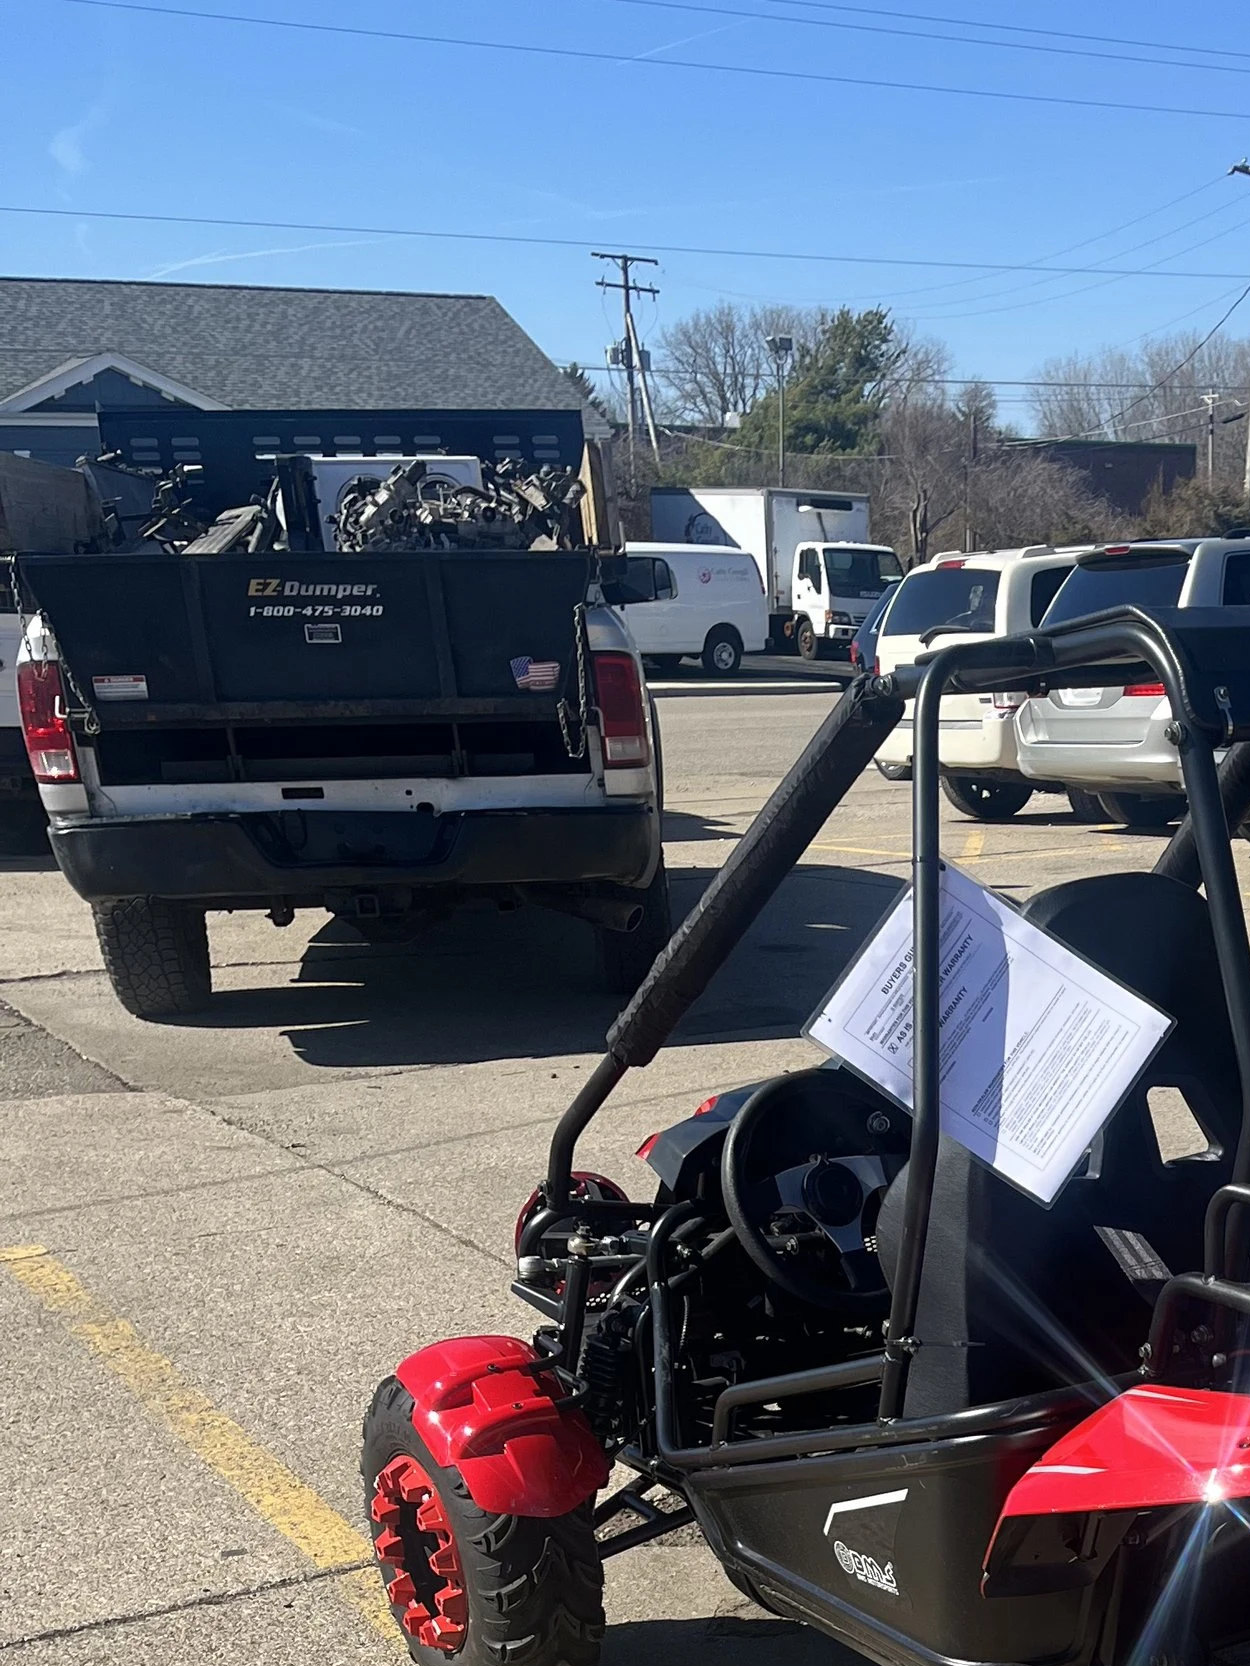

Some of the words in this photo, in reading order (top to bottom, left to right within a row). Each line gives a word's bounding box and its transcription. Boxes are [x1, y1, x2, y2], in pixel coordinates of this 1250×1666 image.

[248, 604, 383, 617] 1-800-475-3040
[880, 960, 907, 995] BUYERS
[895, 1029, 907, 1043] AS
[941, 933, 974, 977] WARRANTY
